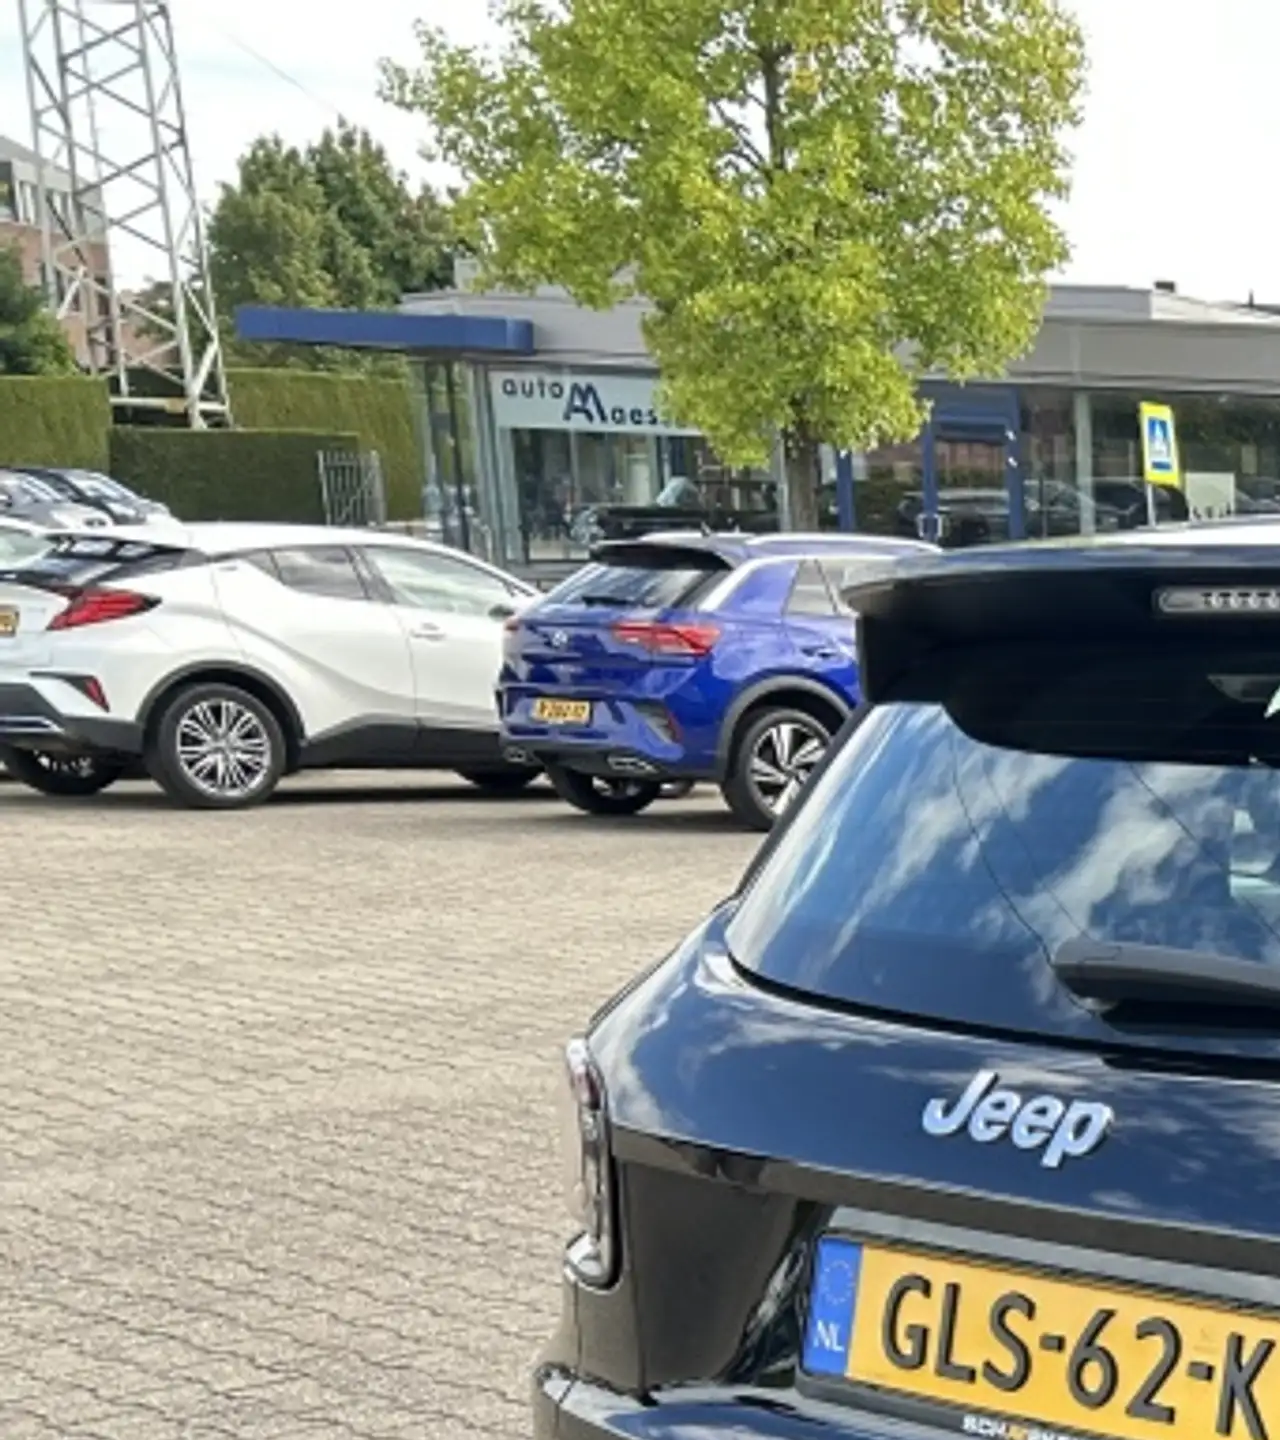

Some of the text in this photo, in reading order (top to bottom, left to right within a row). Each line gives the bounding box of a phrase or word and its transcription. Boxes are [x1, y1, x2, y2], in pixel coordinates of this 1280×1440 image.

[502, 376, 564, 400] auto
[922, 1069, 1114, 1169] Jeep
[812, 1319, 845, 1353] NL
